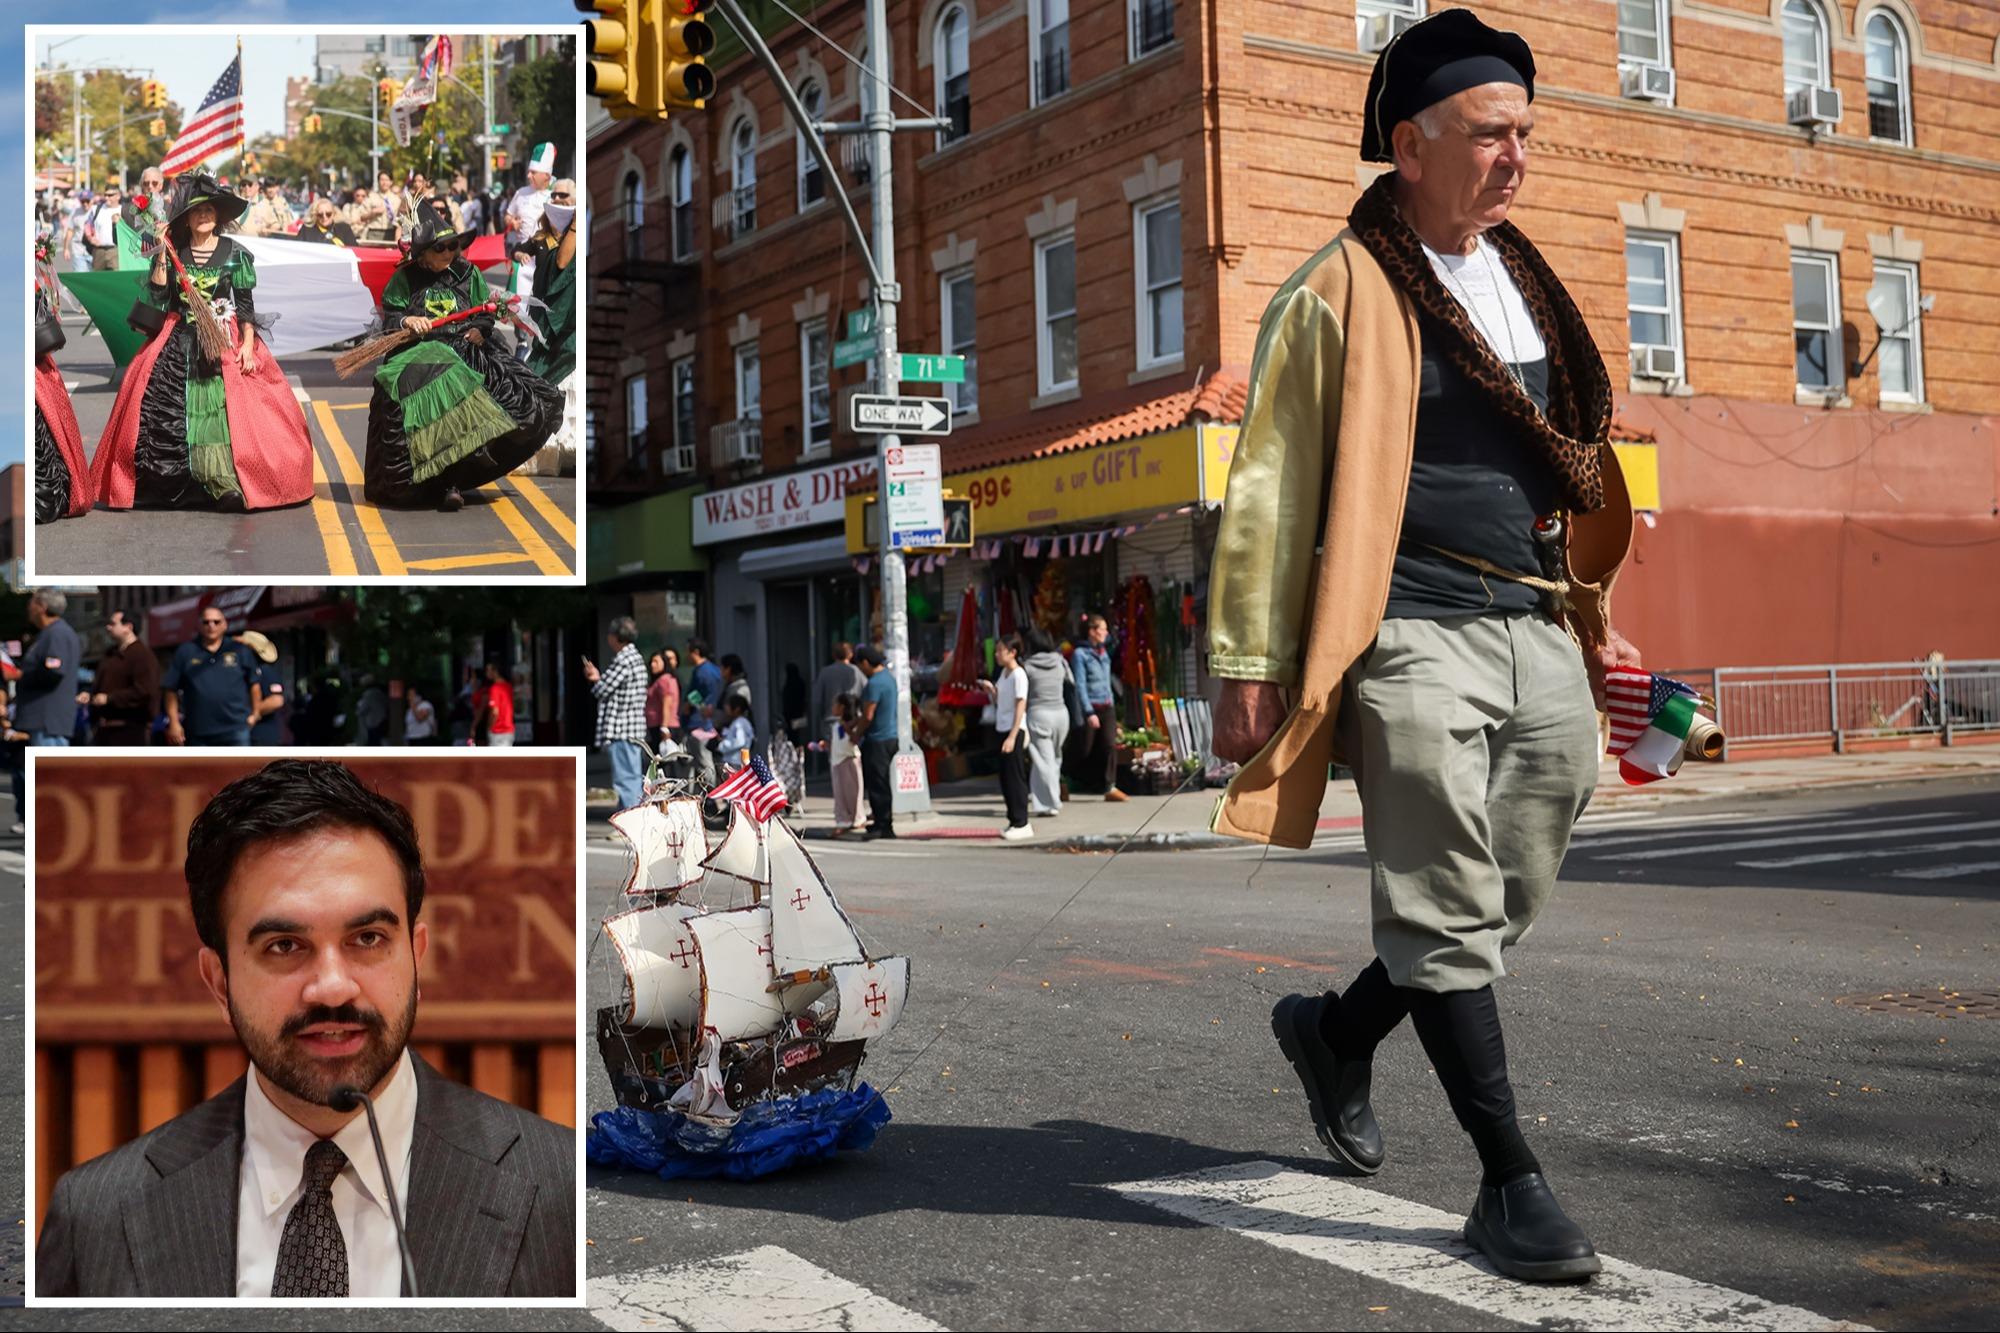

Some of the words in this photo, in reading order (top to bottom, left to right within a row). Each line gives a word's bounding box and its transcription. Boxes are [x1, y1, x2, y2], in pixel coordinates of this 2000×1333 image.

[917, 358, 932, 378] 71
[864, 406, 889, 420] ONE
[898, 407, 924, 421] WAY
[703, 483, 775, 526] WASH
[783, 477, 801, 511] &
[968, 474, 1011, 510] 99¢
[1071, 471, 1087, 490] UP
[1093, 446, 1141, 486] GIFT
[404, 780, 576, 867] DE
